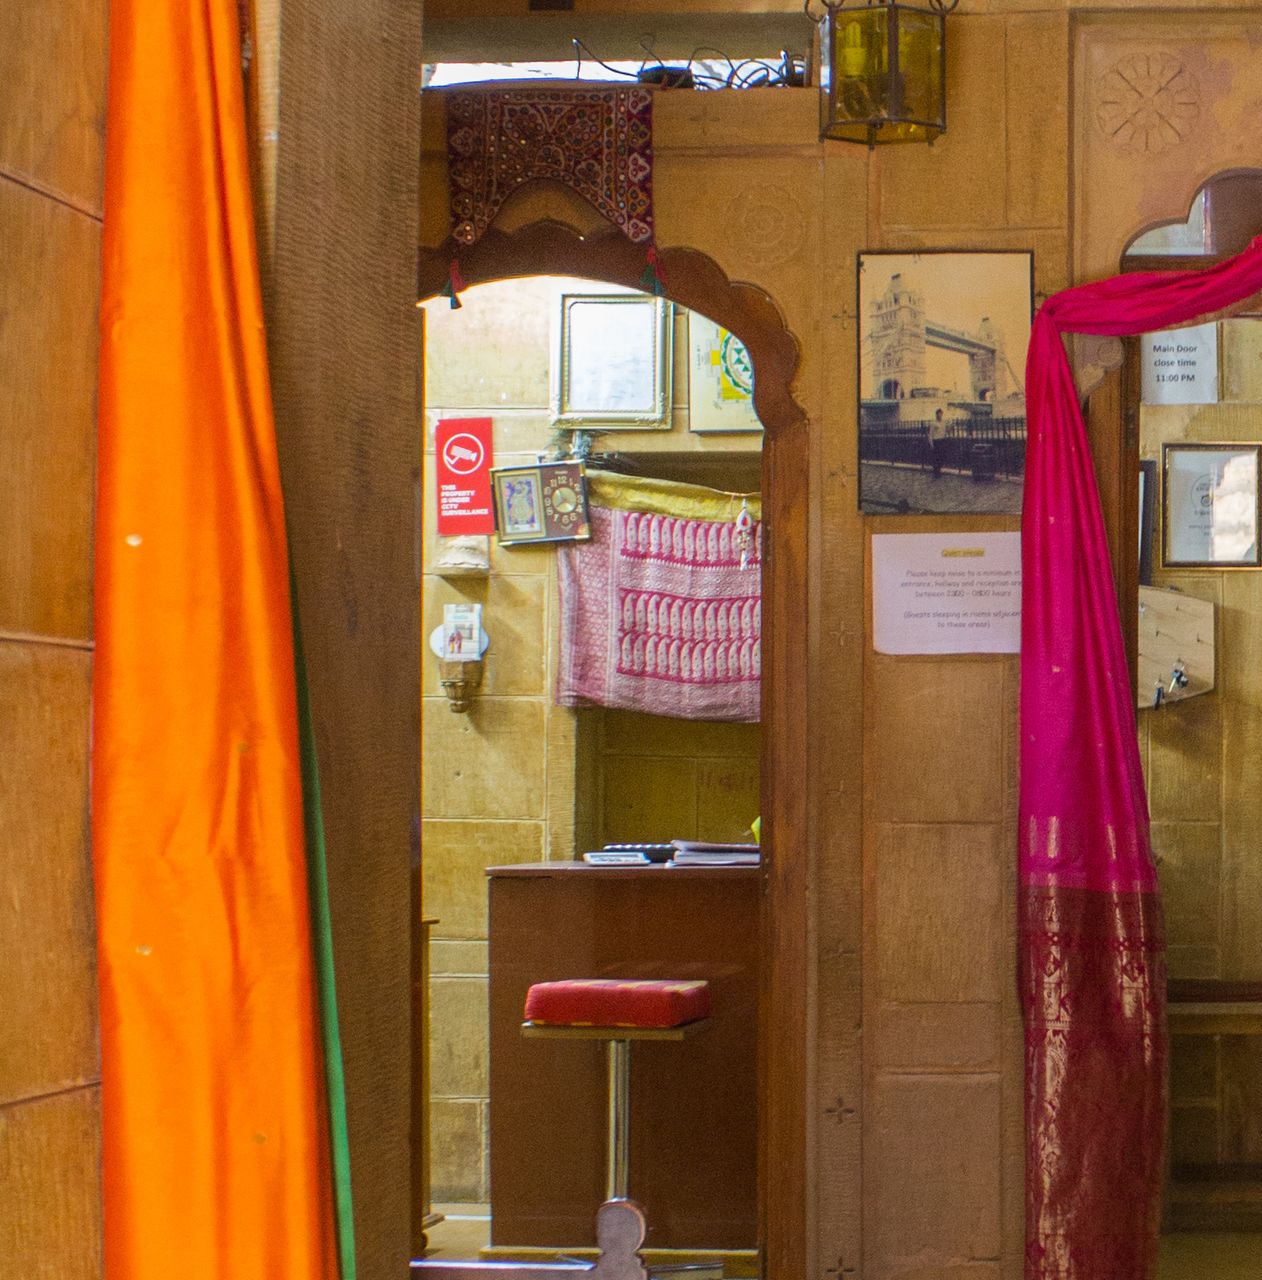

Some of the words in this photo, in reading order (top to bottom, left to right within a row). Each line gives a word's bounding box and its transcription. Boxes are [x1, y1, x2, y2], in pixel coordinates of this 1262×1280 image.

[1152, 344, 1175, 353] Main
[1176, 344, 1198, 353] Door
[1153, 359, 1175, 367] close
[1177, 359, 1197, 367] time
[1156, 374, 1179, 382] 11:00
[1180, 374, 1195, 382] PM
